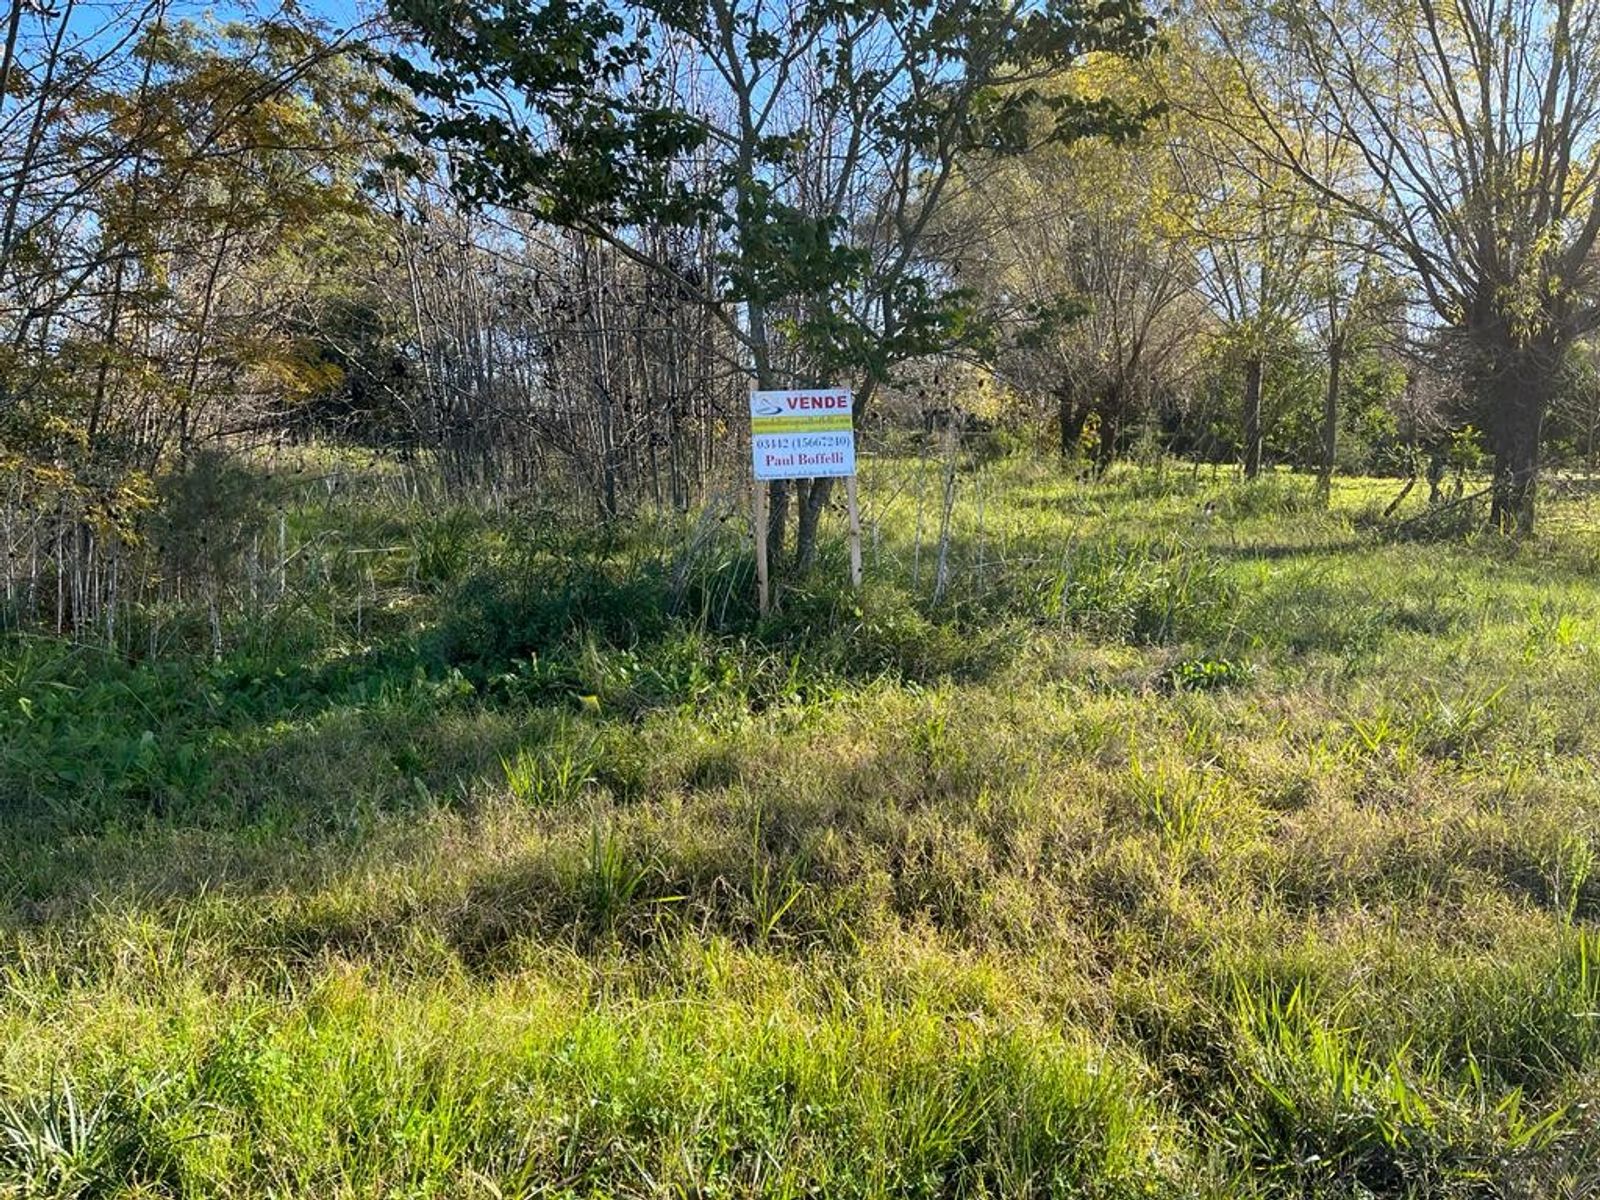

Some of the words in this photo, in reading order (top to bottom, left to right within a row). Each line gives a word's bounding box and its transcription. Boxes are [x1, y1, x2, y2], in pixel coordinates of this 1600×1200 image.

[787, 395, 848, 410] VENDE
[765, 454, 794, 466] Paul
[799, 452, 844, 465] Boffelli
